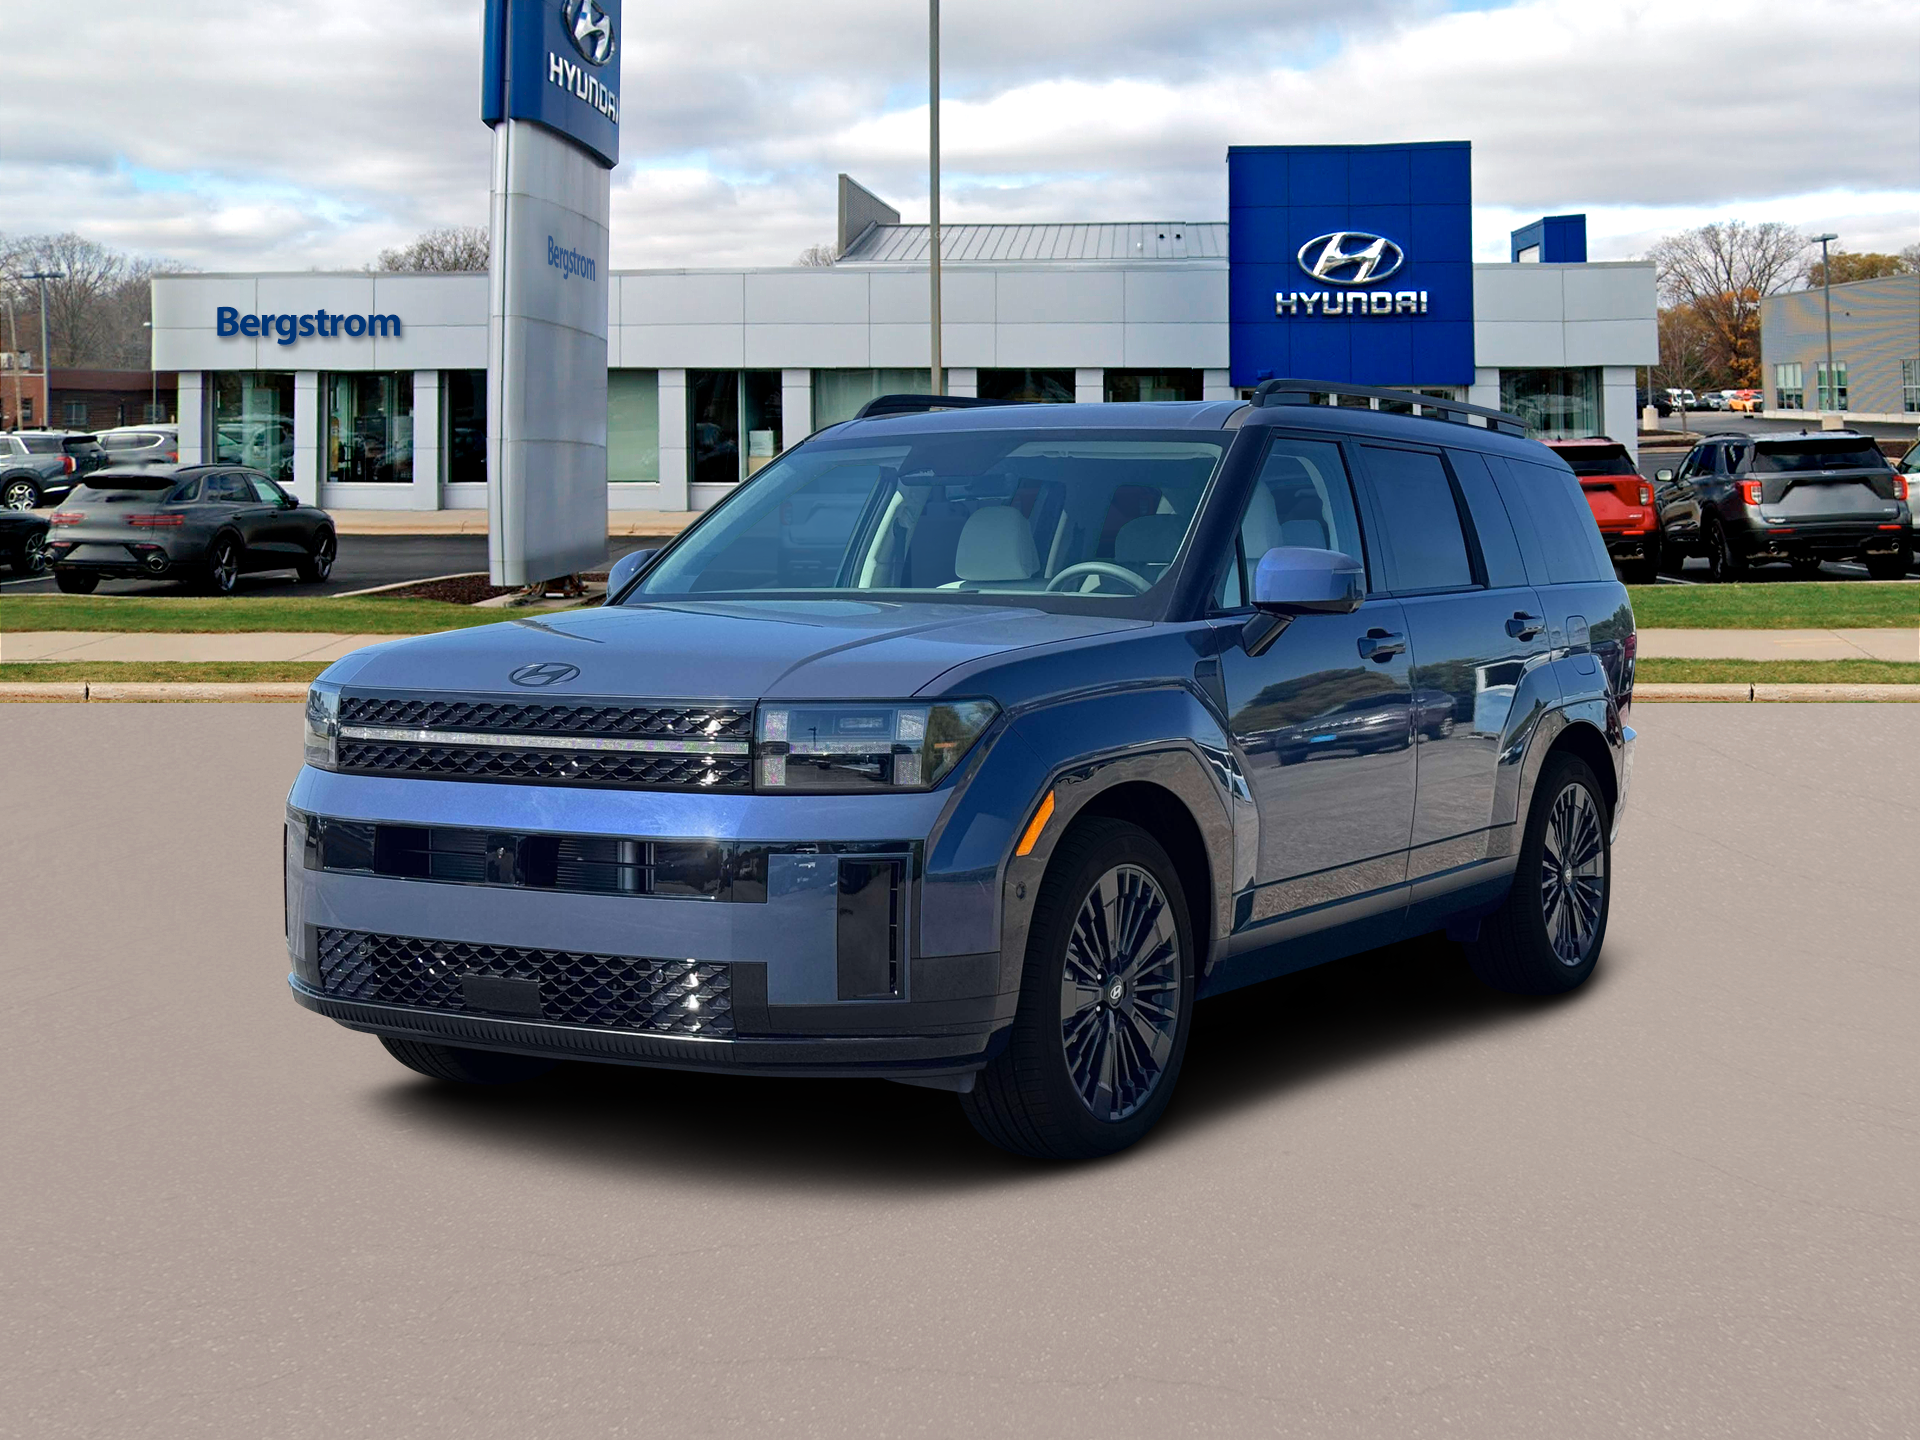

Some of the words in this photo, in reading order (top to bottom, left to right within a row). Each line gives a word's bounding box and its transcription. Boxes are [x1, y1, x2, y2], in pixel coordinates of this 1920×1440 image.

[549, 52, 619, 124] HYUNDAI
[547, 235, 596, 282] Bergstrom
[1275, 291, 1428, 315] HYUNDAI
[216, 306, 402, 346] Bergstrom
